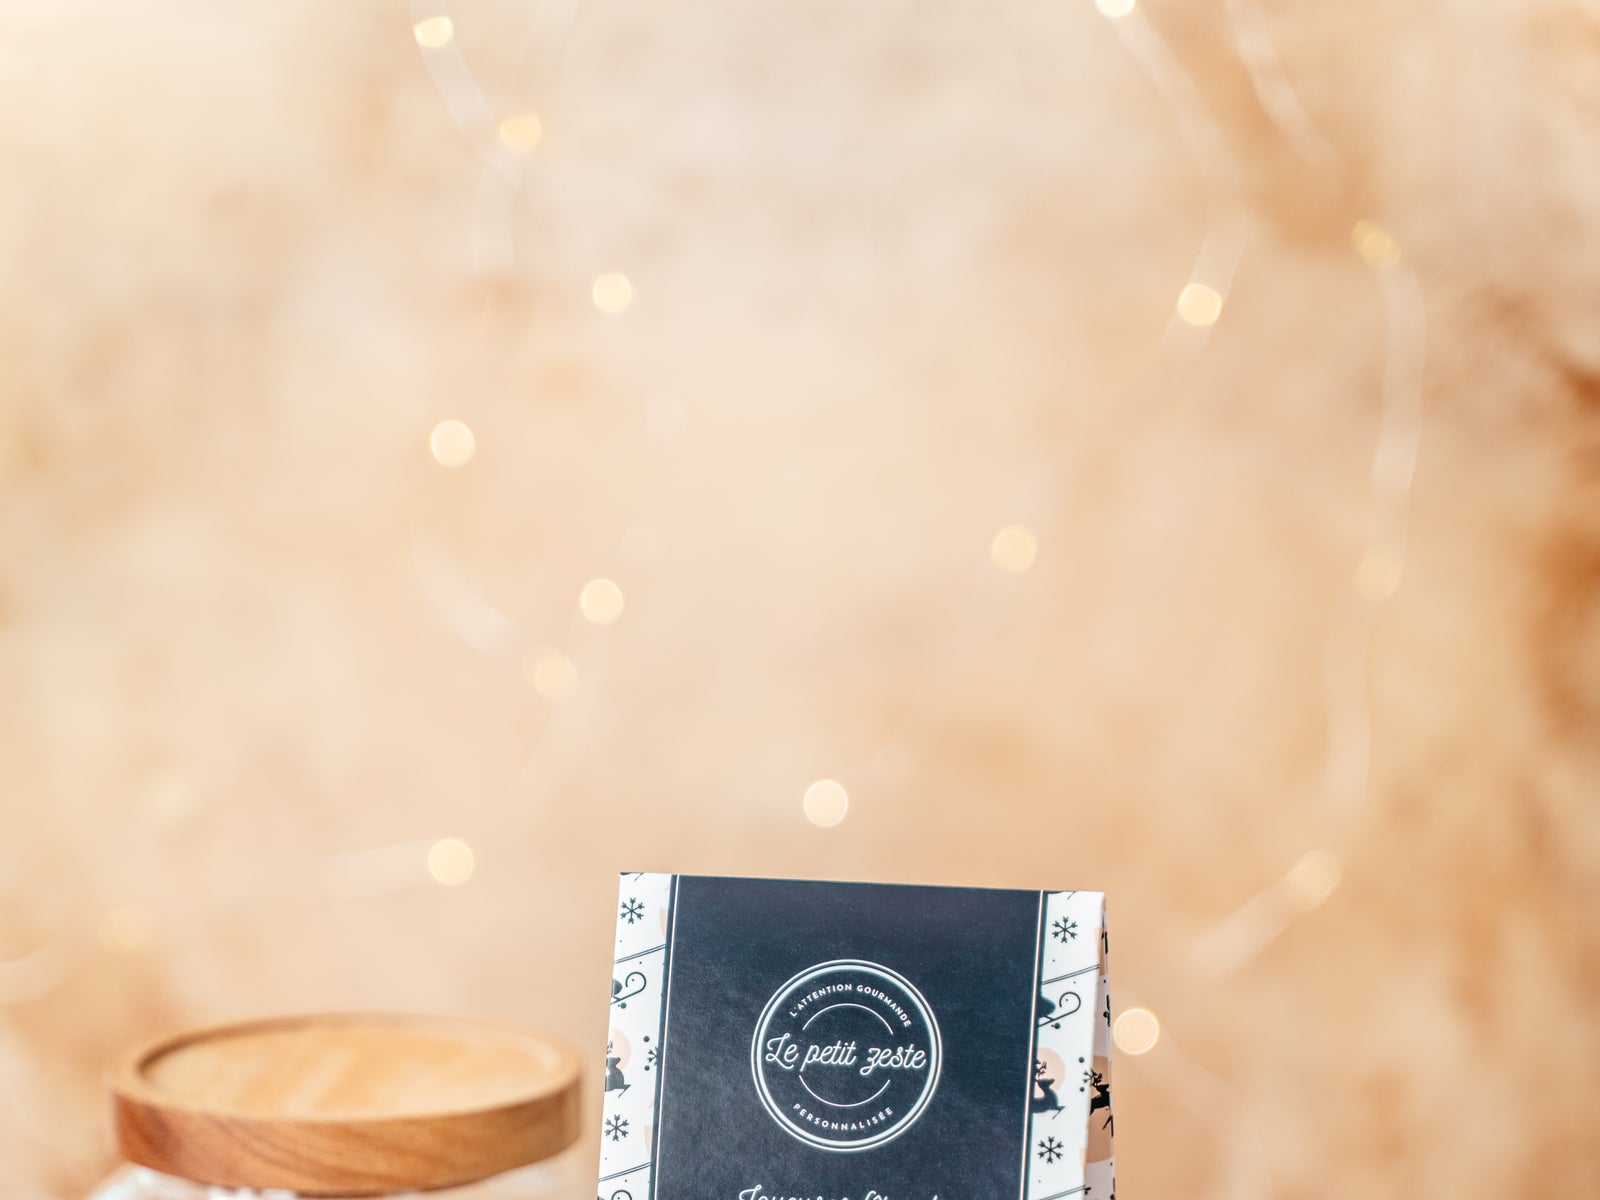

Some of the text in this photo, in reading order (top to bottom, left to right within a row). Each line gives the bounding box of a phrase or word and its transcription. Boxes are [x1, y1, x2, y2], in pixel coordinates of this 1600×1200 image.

[789, 983, 912, 1027] L'ATTENTION GOURMANDE
[765, 1032, 927, 1076] Le petit zeste
[793, 1102, 894, 1131] PERSONNALISÉE
